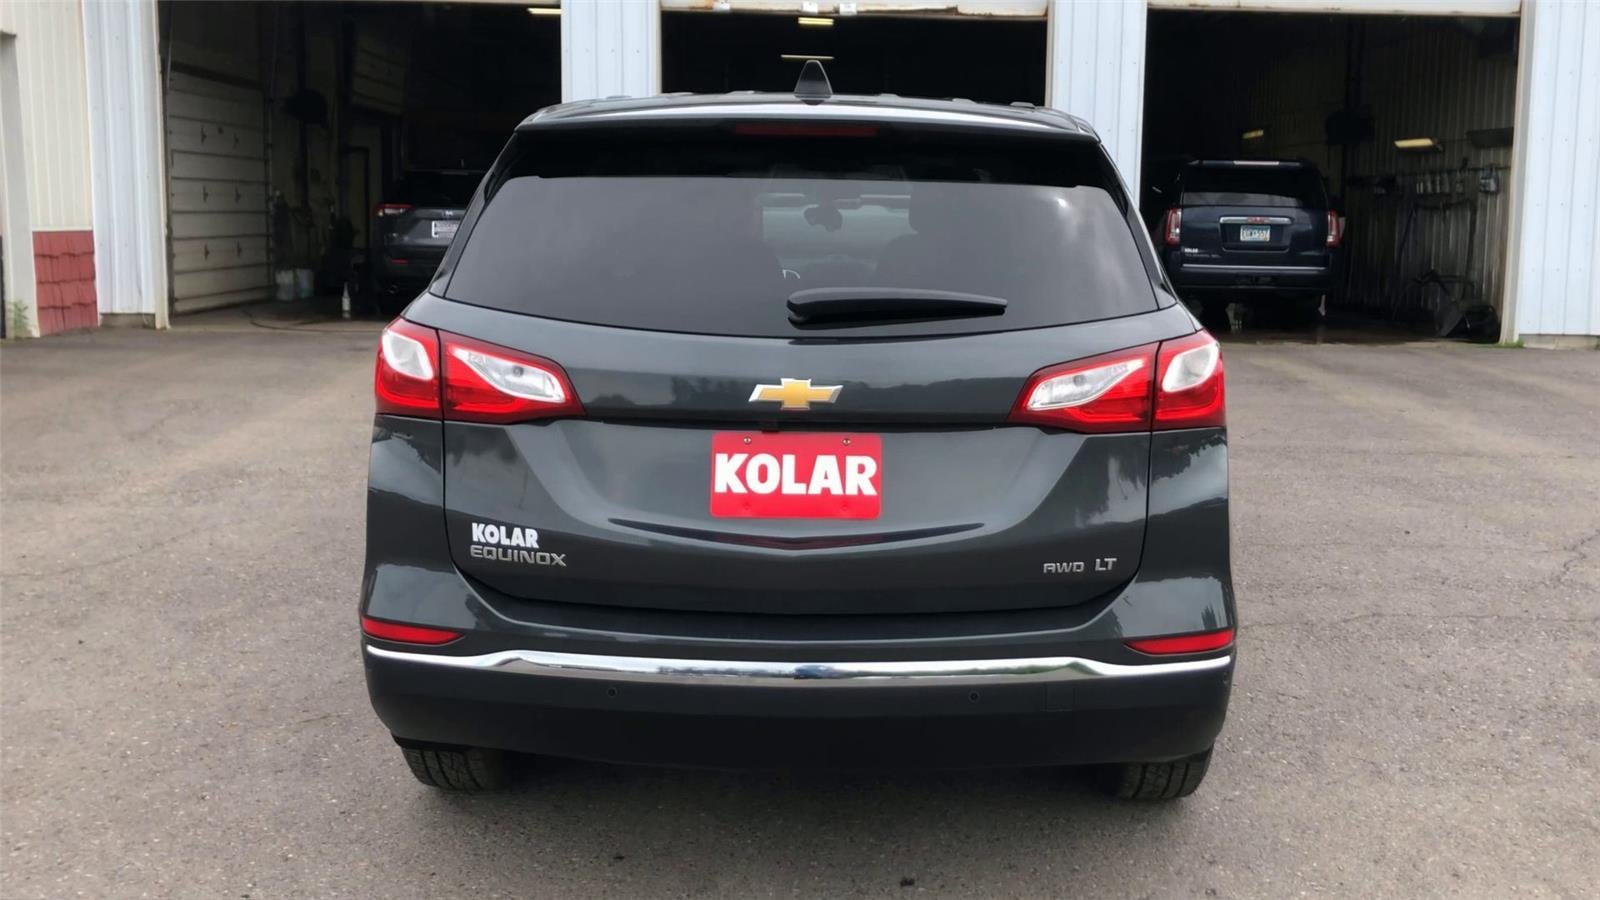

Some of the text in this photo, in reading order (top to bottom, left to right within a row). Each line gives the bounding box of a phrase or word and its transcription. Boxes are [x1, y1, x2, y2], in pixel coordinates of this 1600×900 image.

[714, 453, 878, 495] KOLAR
[472, 522, 539, 548] KOLAR
[470, 544, 567, 567] EQUINOX
[1043, 558, 1117, 573] AWD LT
